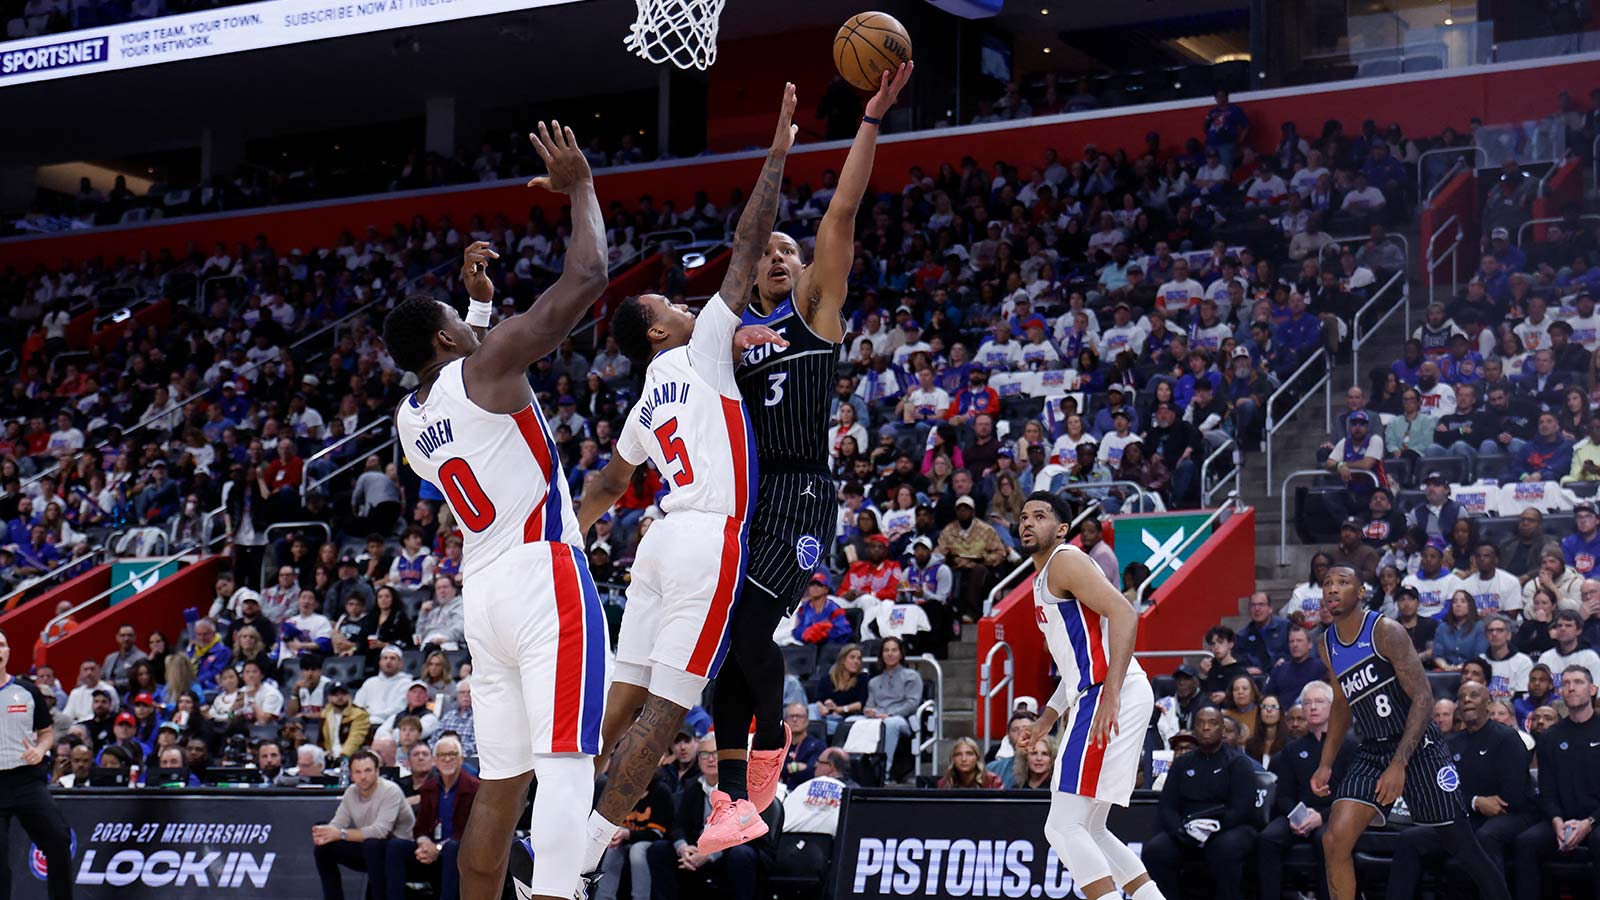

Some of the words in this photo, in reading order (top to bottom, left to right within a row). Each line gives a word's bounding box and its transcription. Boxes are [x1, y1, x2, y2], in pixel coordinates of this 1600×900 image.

[120, 29, 150, 44] YOUR
[189, 17, 221, 35] YOUR
[284, 6, 353, 28] SUBSCRIBE
[357, 3, 385, 16] NOW
[2, 39, 105, 74] SPORTSNET
[120, 44, 151, 59] YOUR
[154, 35, 213, 54] NETWORK.
[680, 382, 691, 405] II
[764, 371, 788, 407] 3
[415, 418, 454, 459] DUREN
[653, 416, 694, 488] 5
[438, 457, 496, 533] 0
[1374, 694, 1392, 718] 8
[91, 823, 157, 843] 2026-27
[160, 823, 272, 845] MEMBERSHIPS
[75, 849, 221, 887] LOCK
[217, 851, 277, 888] IN
